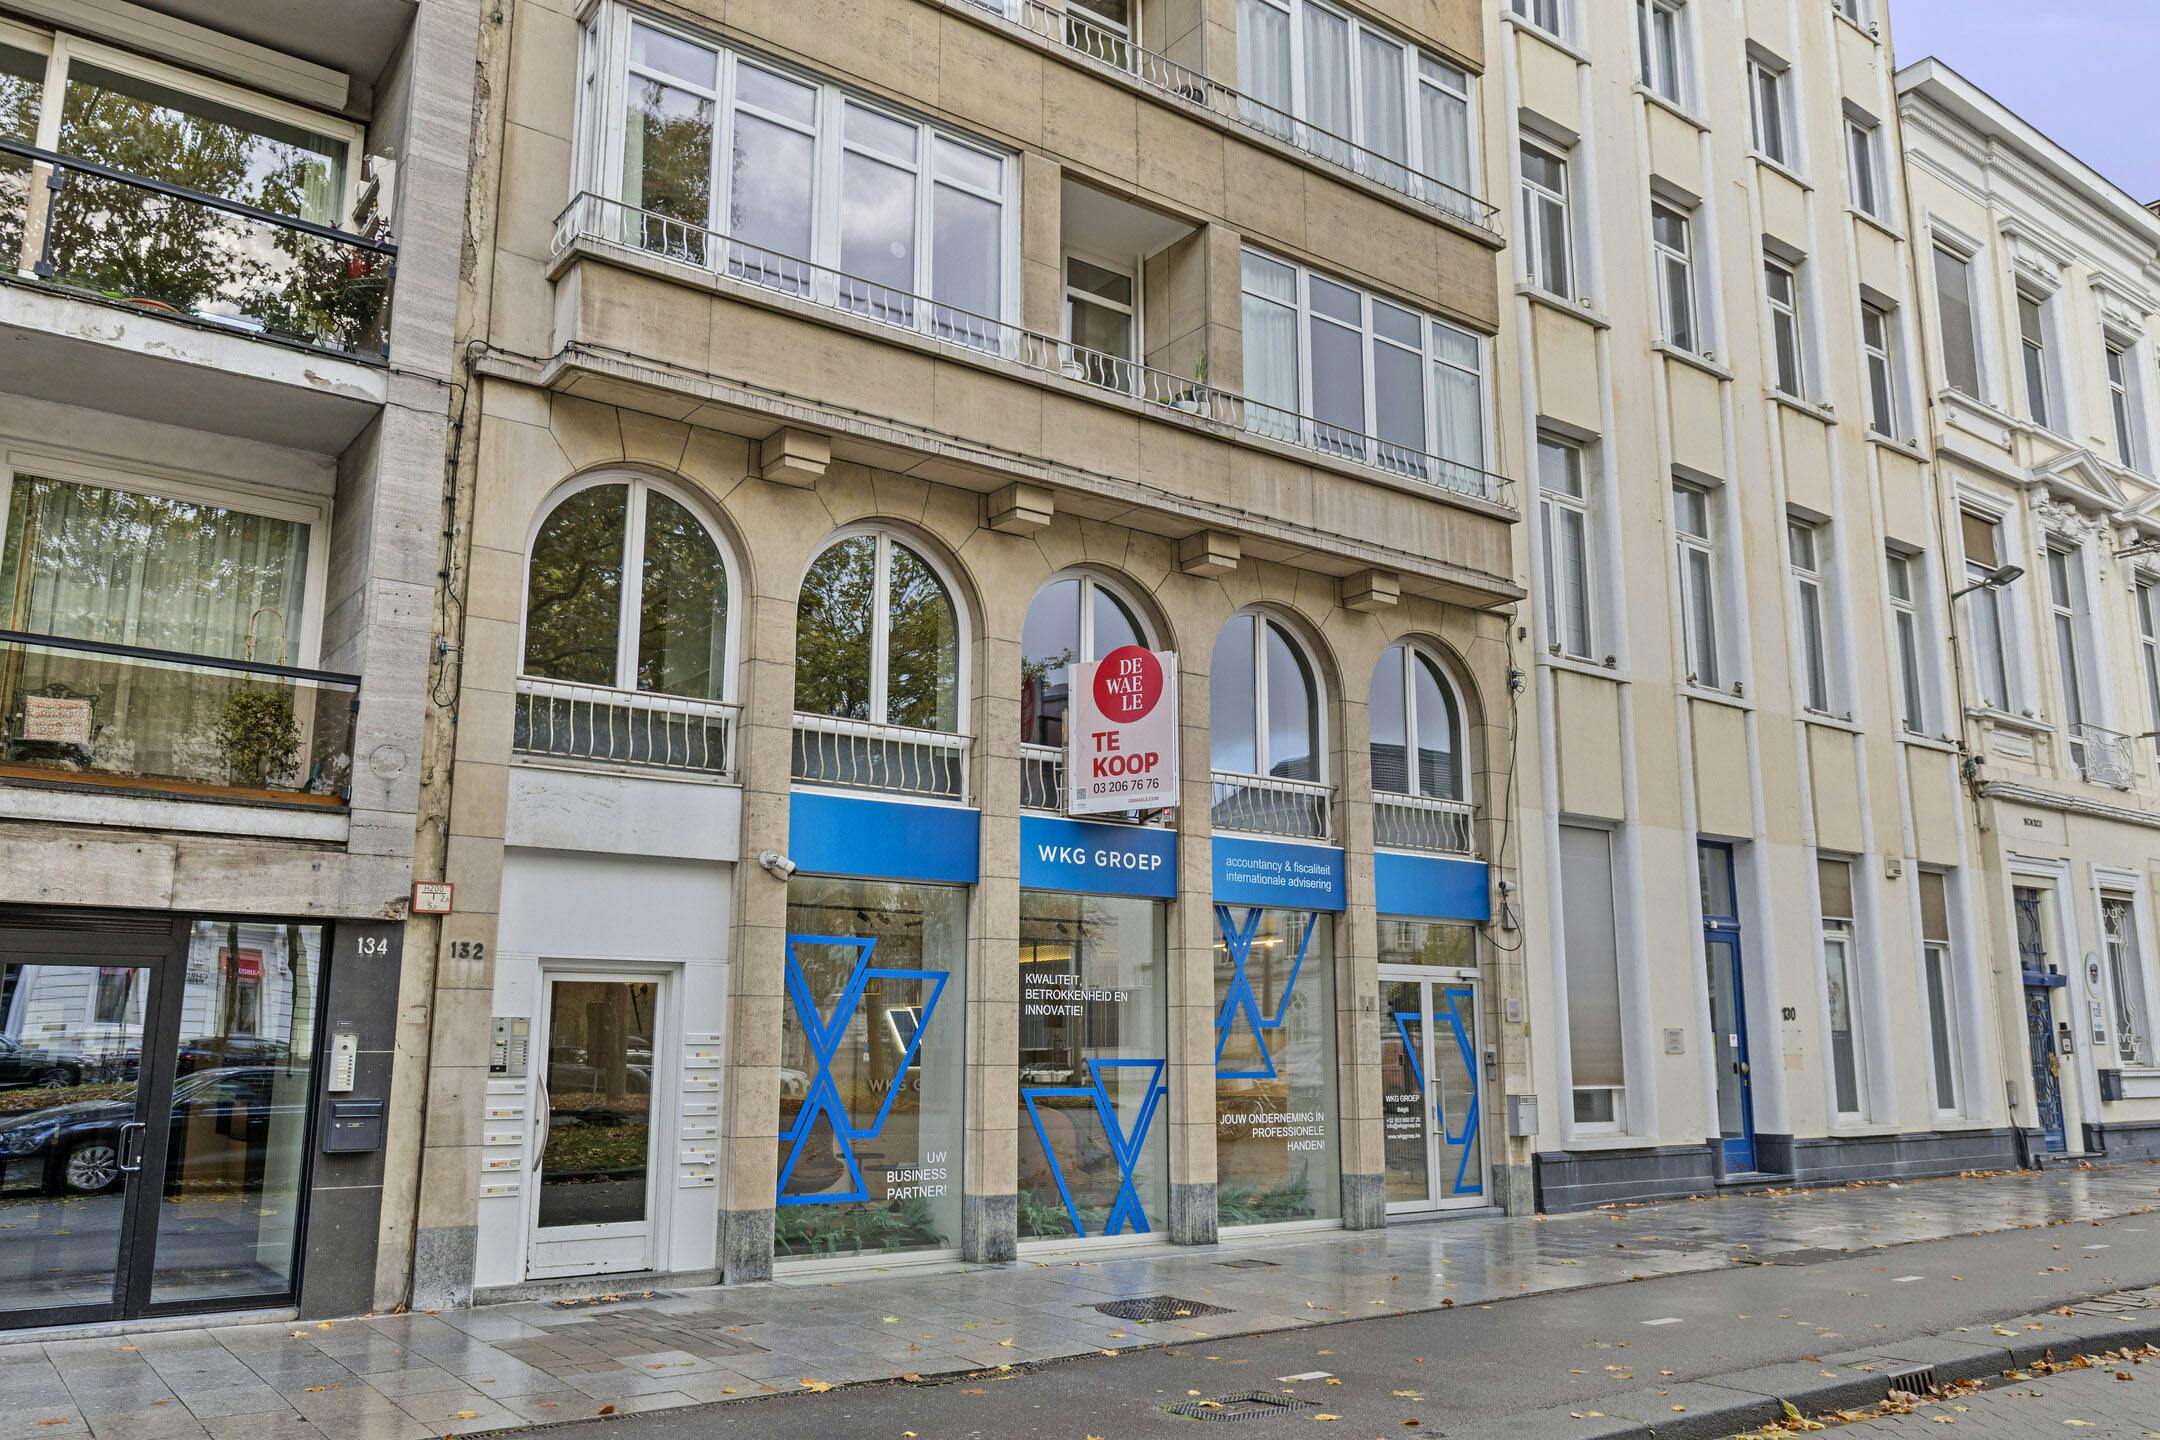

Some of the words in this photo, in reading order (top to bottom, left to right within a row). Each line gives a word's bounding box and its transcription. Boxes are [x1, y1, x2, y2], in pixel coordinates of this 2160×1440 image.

[1120, 657, 1143, 676] DE
[1106, 675, 1143, 695] WAE
[1121, 693, 1143, 711] LE
[1092, 730, 1120, 753] TE
[1093, 752, 1159, 778] KOOP
[1093, 783, 1106, 794] 03
[1108, 781, 1128, 793] 206
[1131, 779, 1143, 791] 76
[1146, 778, 1159, 789] 76
[1038, 844, 1086, 865] WKG
[1094, 850, 1162, 871] GROEP
[1226, 857, 1282, 874] accountancy
[1284, 861, 1292, 872] &
[1293, 861, 1331, 876] fiscaliteit
[1226, 870, 1286, 886] internationale
[1288, 877, 1332, 892] advisering
[357, 937, 388, 955] 134
[451, 941, 484, 960] 132
[1025, 973, 1083, 987] KWALITEIT,
[1025, 989, 1112, 1002] BETROKKENHEID
[1114, 991, 1128, 1002] EN
[1025, 1004, 1083, 1016] INNOVATIE!
[1782, 1006, 1796, 1021] 130
[1385, 1095, 1400, 1103] WKG
[1400, 1094, 1420, 1103] GROEP
[1220, 1114, 1247, 1125] JOUW
[1248, 1112, 1314, 1124] ONDERNEMING
[1316, 1112, 1325, 1122] IN
[1252, 1126, 1325, 1138] PROFESSIONELE
[1287, 1140, 1326, 1151] HANDEN!
[927, 1151, 947, 1163] UW
[887, 1168, 947, 1183] BUSINESS
[887, 1185, 947, 1201] PARTNER!
